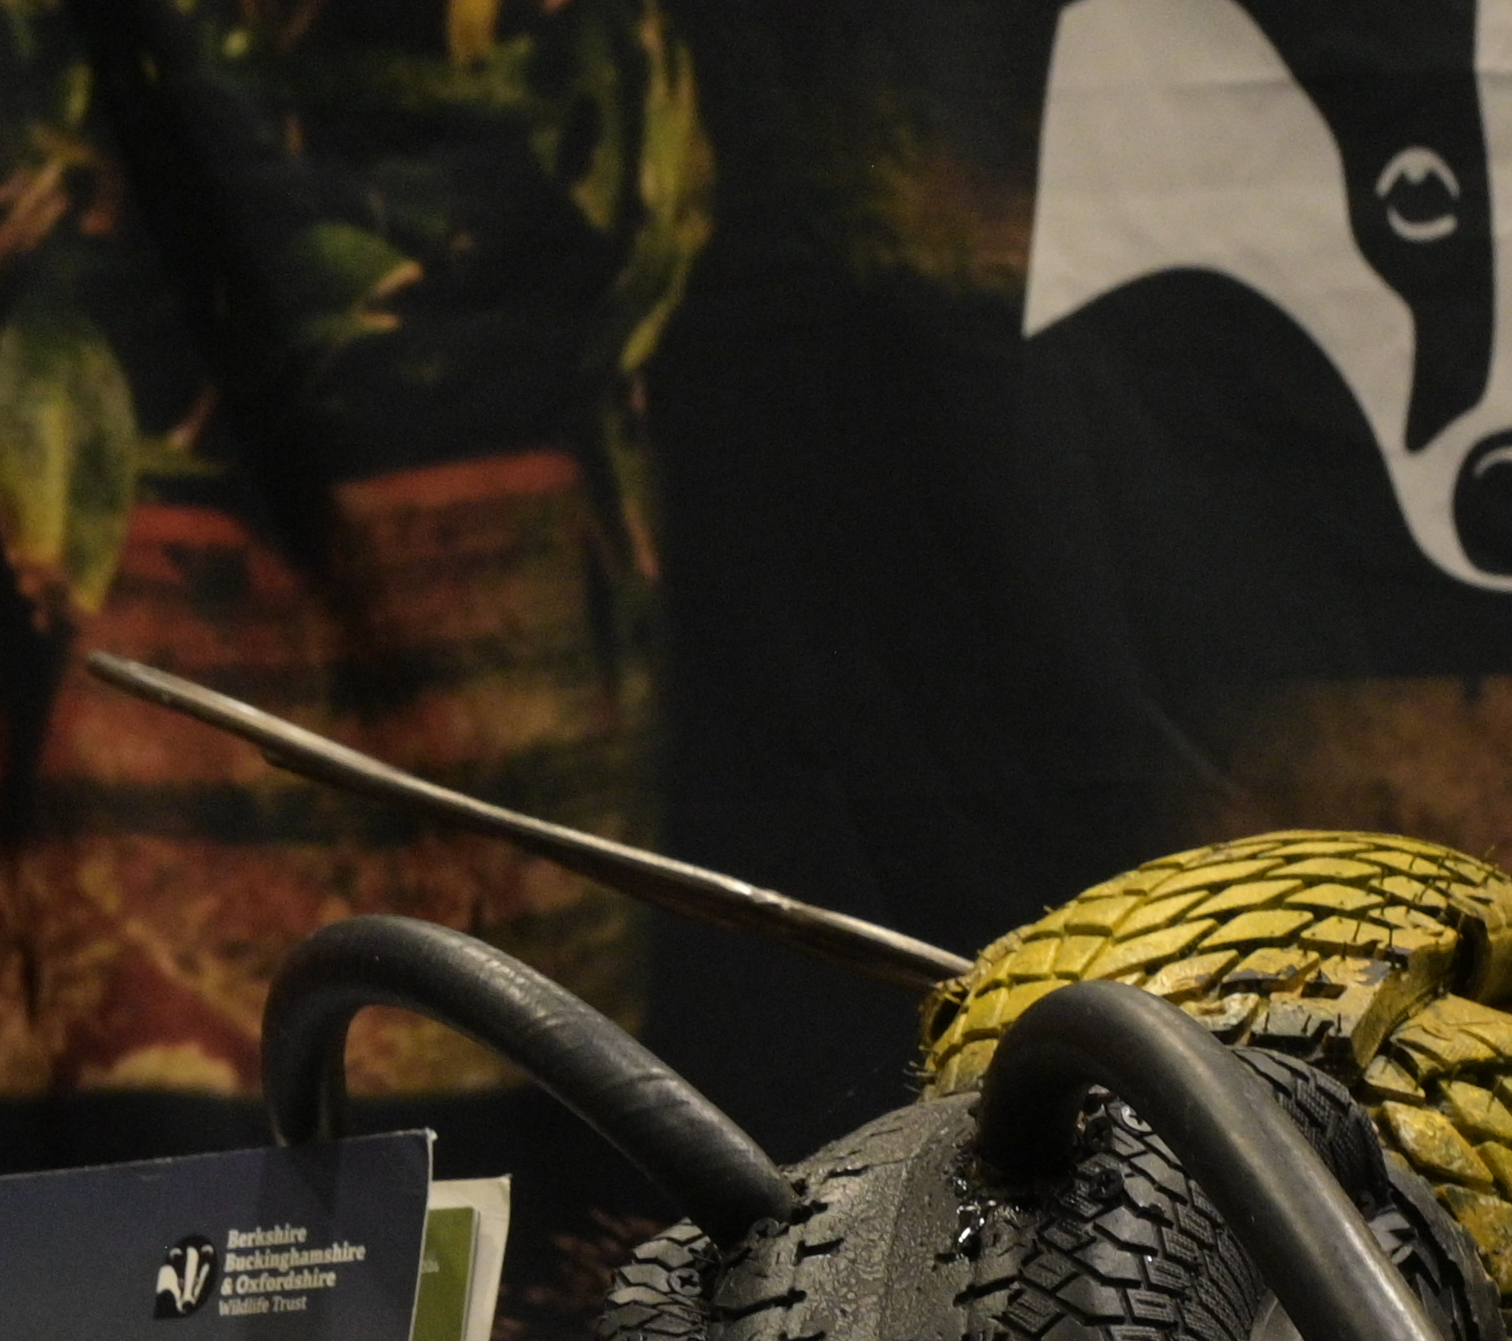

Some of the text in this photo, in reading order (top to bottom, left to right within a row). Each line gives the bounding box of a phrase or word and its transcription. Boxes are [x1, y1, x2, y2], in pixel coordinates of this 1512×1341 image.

[227, 1223, 307, 1249] Berkshire
[224, 1241, 366, 1272] Buckinghamshire
[220, 1268, 336, 1295] & Oxfordshire
[219, 1295, 307, 1316] Wildlife Trust
